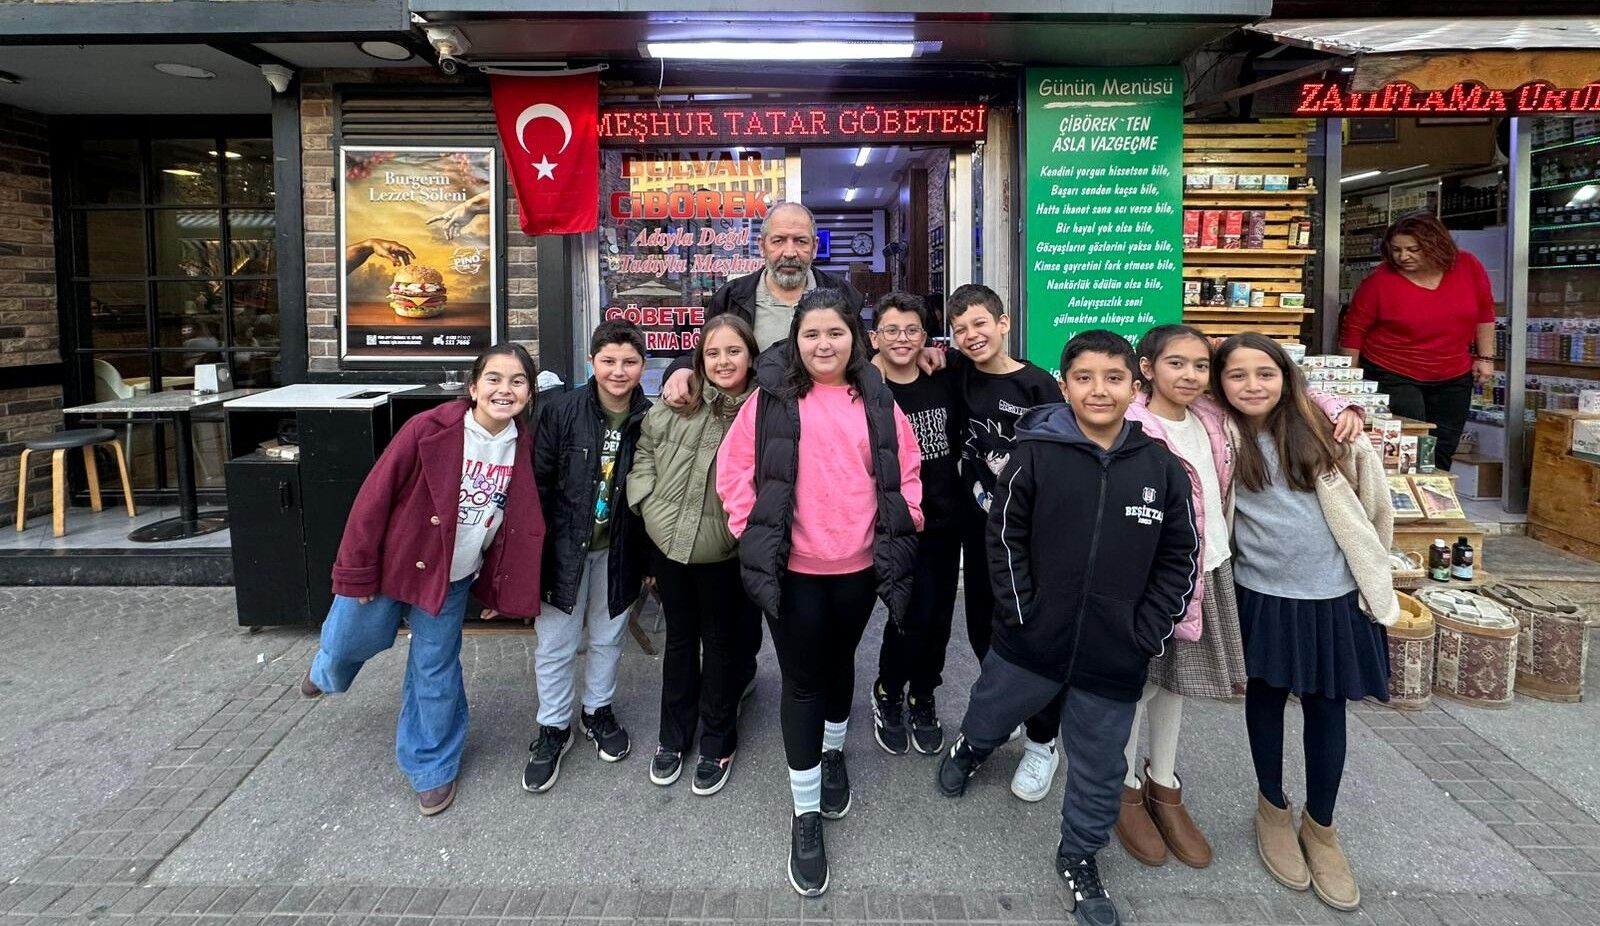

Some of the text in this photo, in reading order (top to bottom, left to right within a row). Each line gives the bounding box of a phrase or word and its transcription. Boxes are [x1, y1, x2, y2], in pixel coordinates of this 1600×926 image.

[1039, 78, 1173, 96] Günün Menüsü
[597, 105, 985, 143] MEŞHUR TATAR GÖBETESİ
[1052, 135, 1159, 154] ASLA VAZGEÇME
[1040, 164, 1170, 179] Kendini yorgun hissetsen bile,
[385, 171, 450, 190] Burgerin
[368, 187, 466, 204] Lezzet Şöleni
[1050, 183, 1160, 198] Başarı senden kaçsa bile,
[1035, 202, 1174, 215] Hatta ihanet sana acı verse bile,
[1056, 221, 1154, 236] Bir hayal yok olsa bile,
[631, 226, 751, 252] Adıyla Değil
[1036, 240, 1174, 255] Gözyaşların gözlerini yaksa bile,
[616, 253, 766, 278] Tadıyla Meşhur
[1034, 259, 1177, 275] Kimse gayretini fark etmese bile,
[1047, 278, 1164, 291] Nankörlük ödülün olsa bile,
[1124, 296, 1144, 307] seni
[1053, 312, 1157, 327] gülmekten alıkoysa bile,
